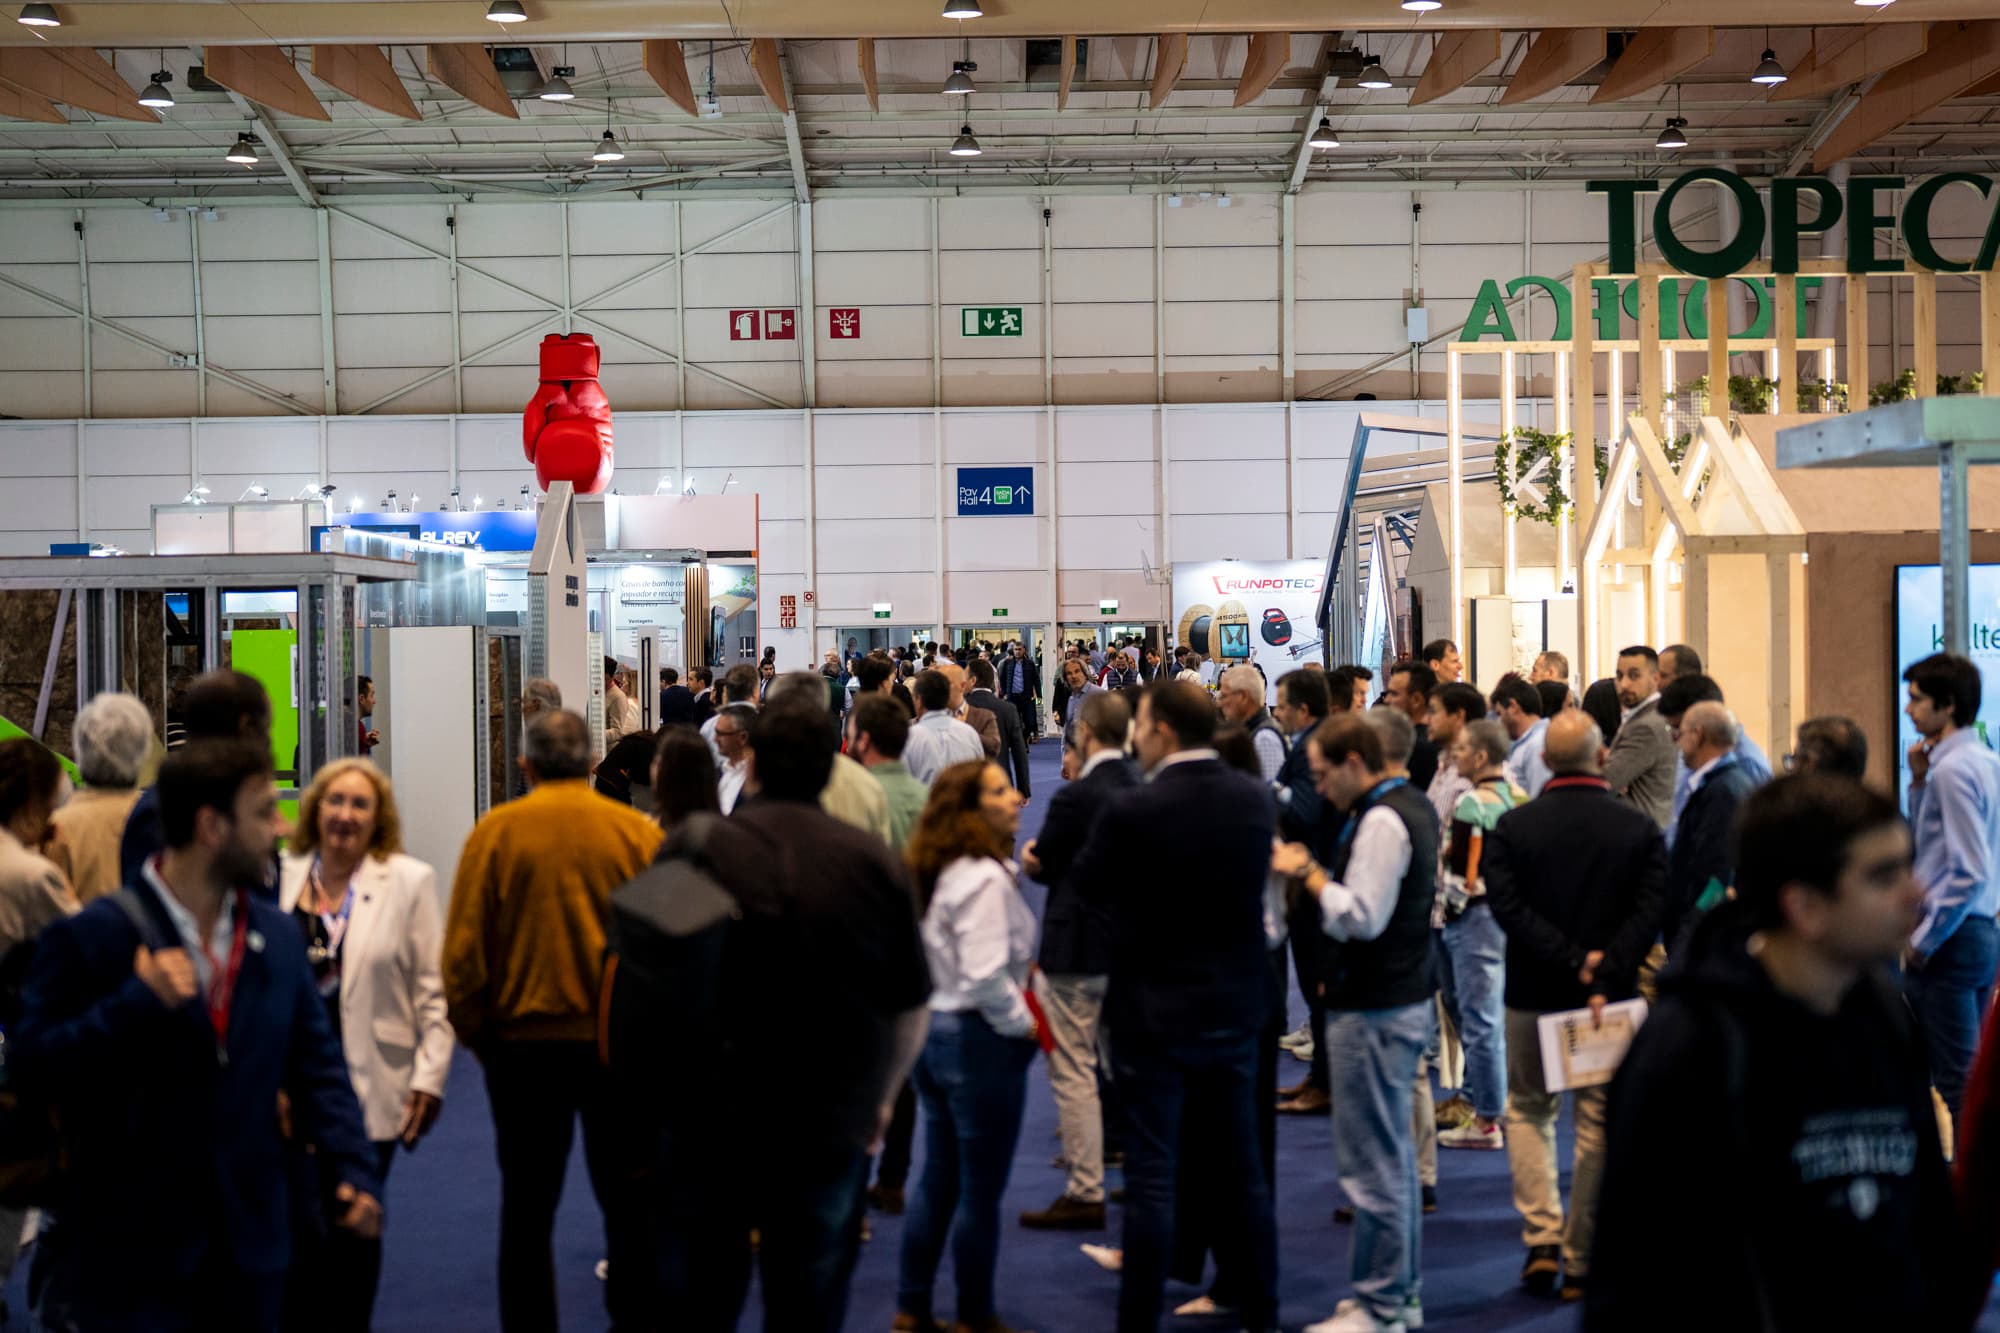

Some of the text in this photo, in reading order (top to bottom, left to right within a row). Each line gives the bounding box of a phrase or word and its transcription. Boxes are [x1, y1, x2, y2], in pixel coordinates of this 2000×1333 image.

[1586, 168, 2000, 278] TOPEC
[959, 486, 978, 497] Pav
[979, 486, 992, 505] 4
[959, 496, 978, 505] Hall
[652, 579, 674, 588] banho
[1226, 578, 1315, 590] RUNPOTEC
